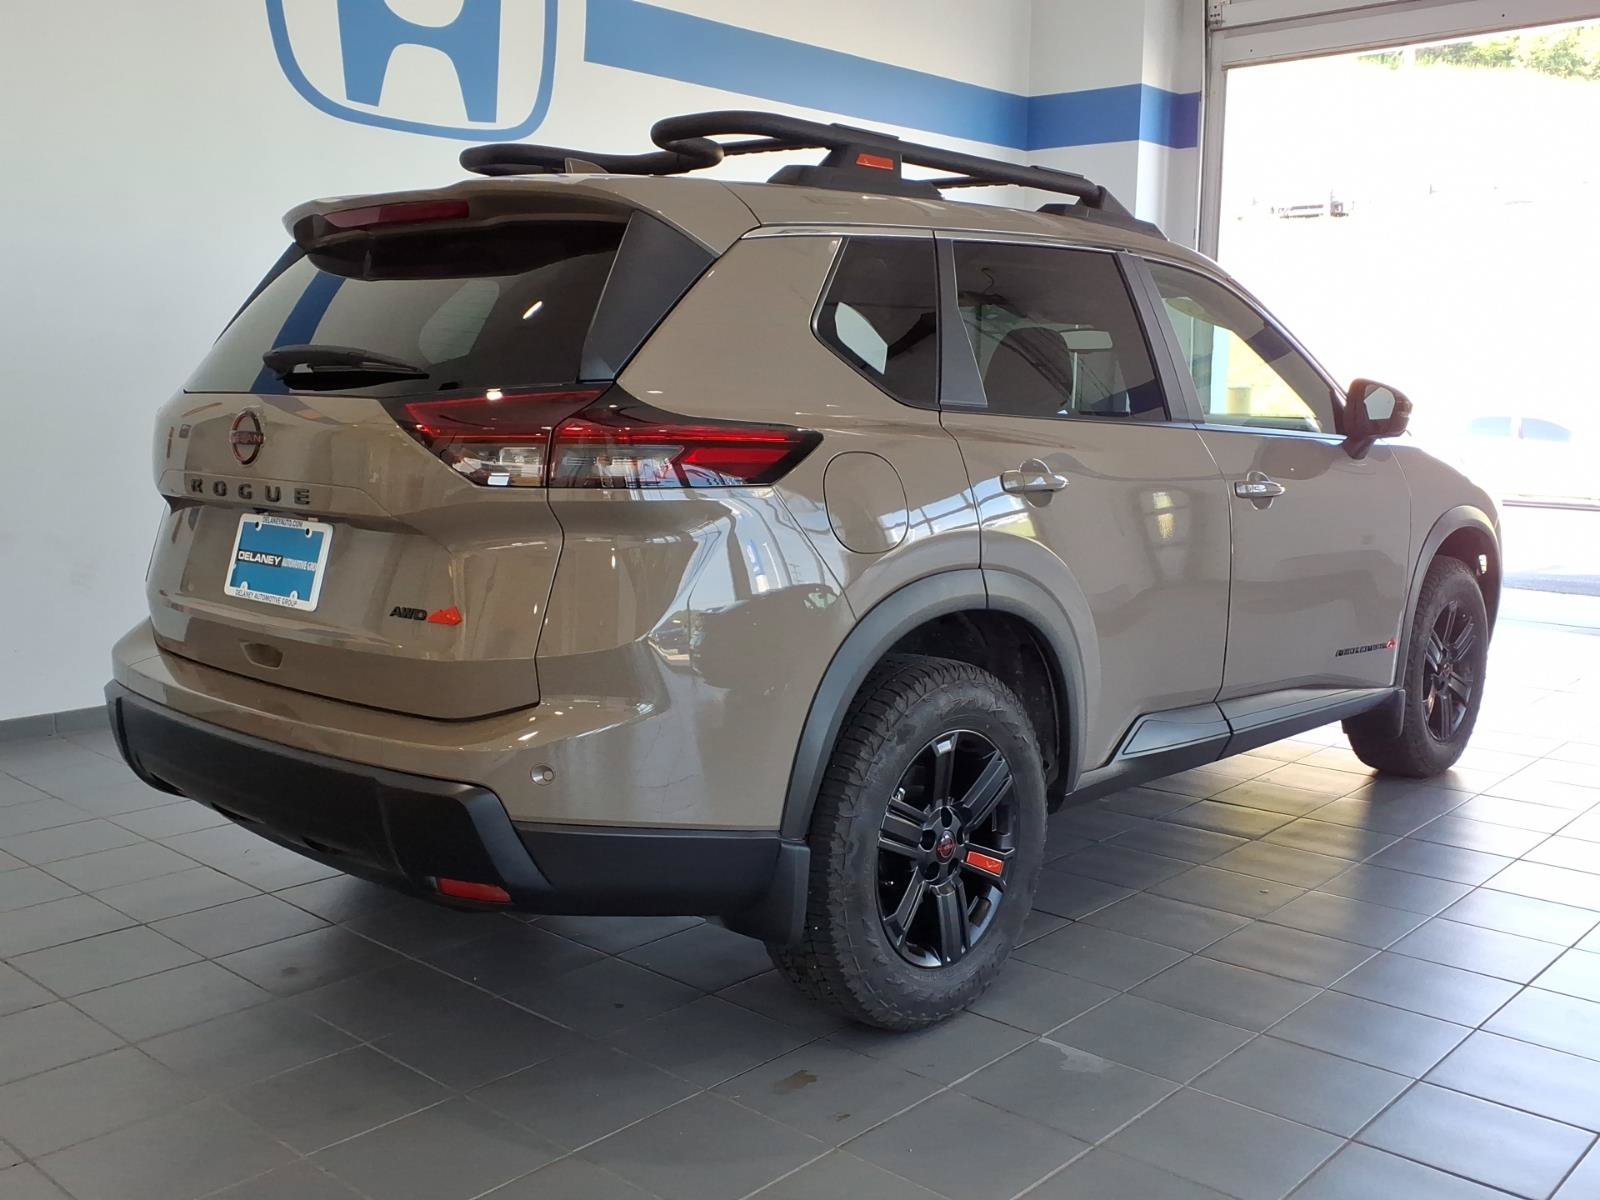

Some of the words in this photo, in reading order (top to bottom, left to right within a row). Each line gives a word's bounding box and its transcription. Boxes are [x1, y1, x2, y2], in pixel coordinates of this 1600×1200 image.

[191, 478, 310, 505] ROGUE
[238, 551, 282, 565] DELANEY
[389, 606, 427, 621] AWD
